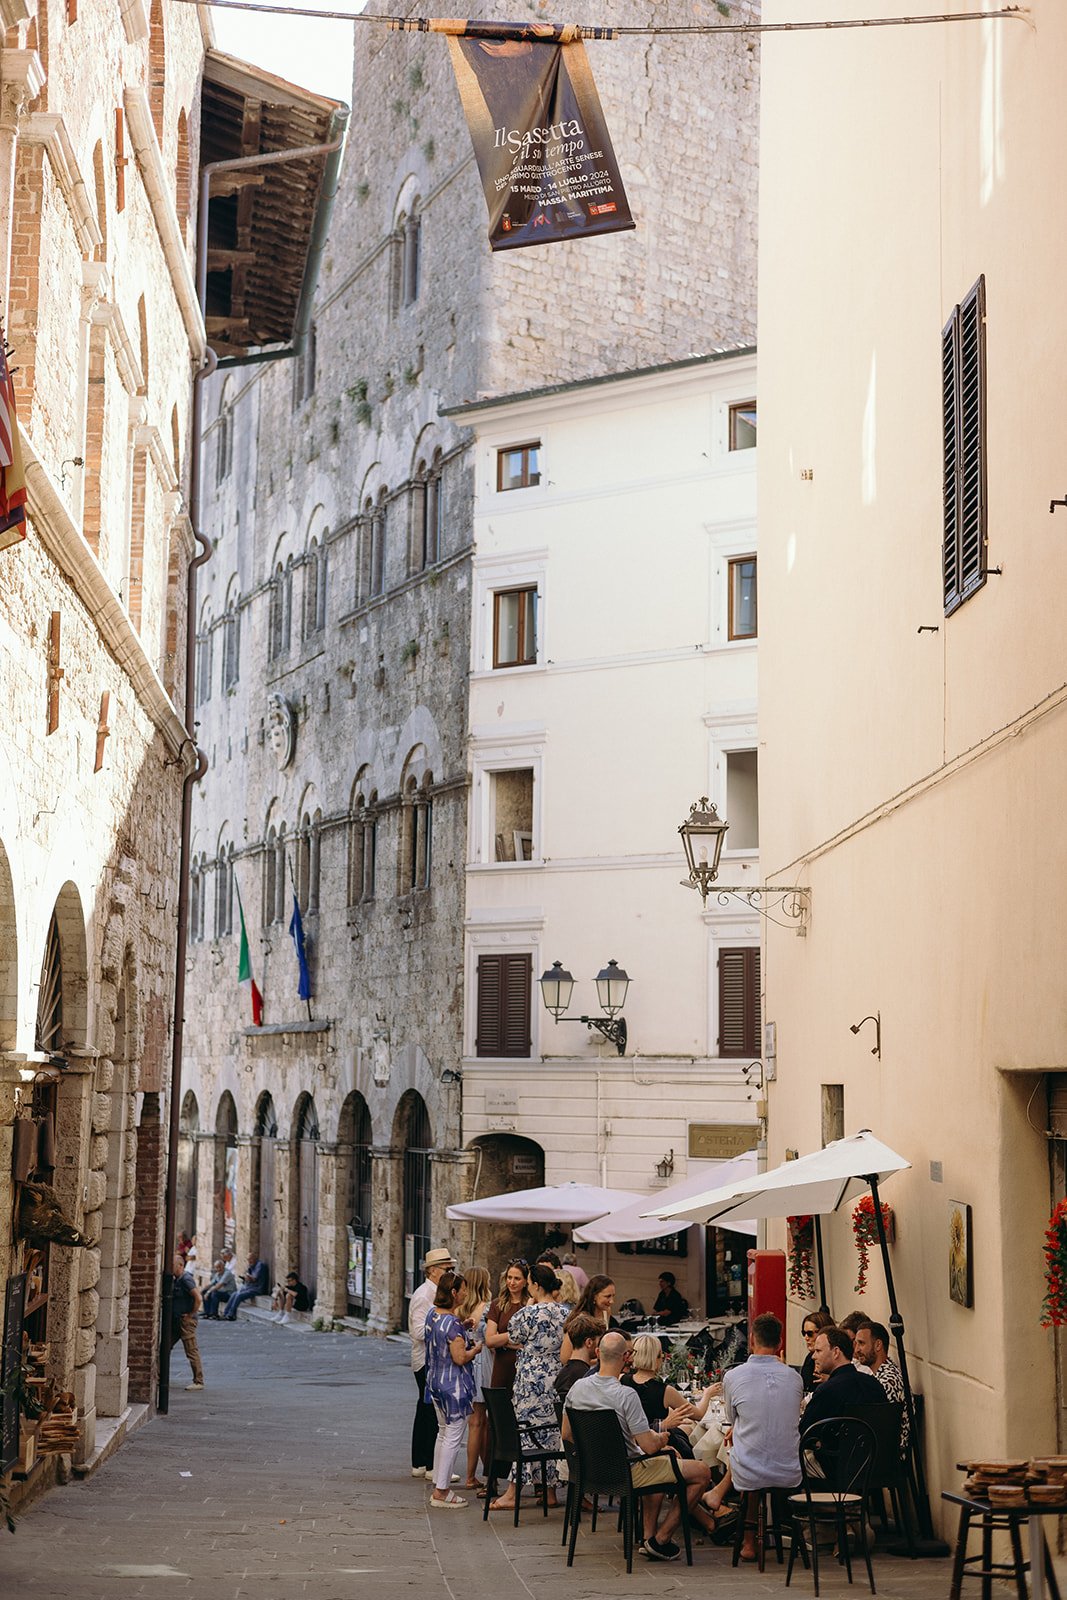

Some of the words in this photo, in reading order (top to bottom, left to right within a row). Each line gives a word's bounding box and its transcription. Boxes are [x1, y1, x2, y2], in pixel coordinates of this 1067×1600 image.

[493, 126, 507, 148] Il
[545, 139, 584, 158] tempo
[575, 150, 604, 162] SENESE
[510, 185, 519, 193] 15
[548, 182, 558, 190] 14
[558, 174, 588, 187] LUGLIO
[589, 170, 609, 181] 2024
[538, 196, 568, 207] MASSA
[568, 185, 614, 200] MARITTIMA
[698, 1135, 745, 1146] OSTERIA
